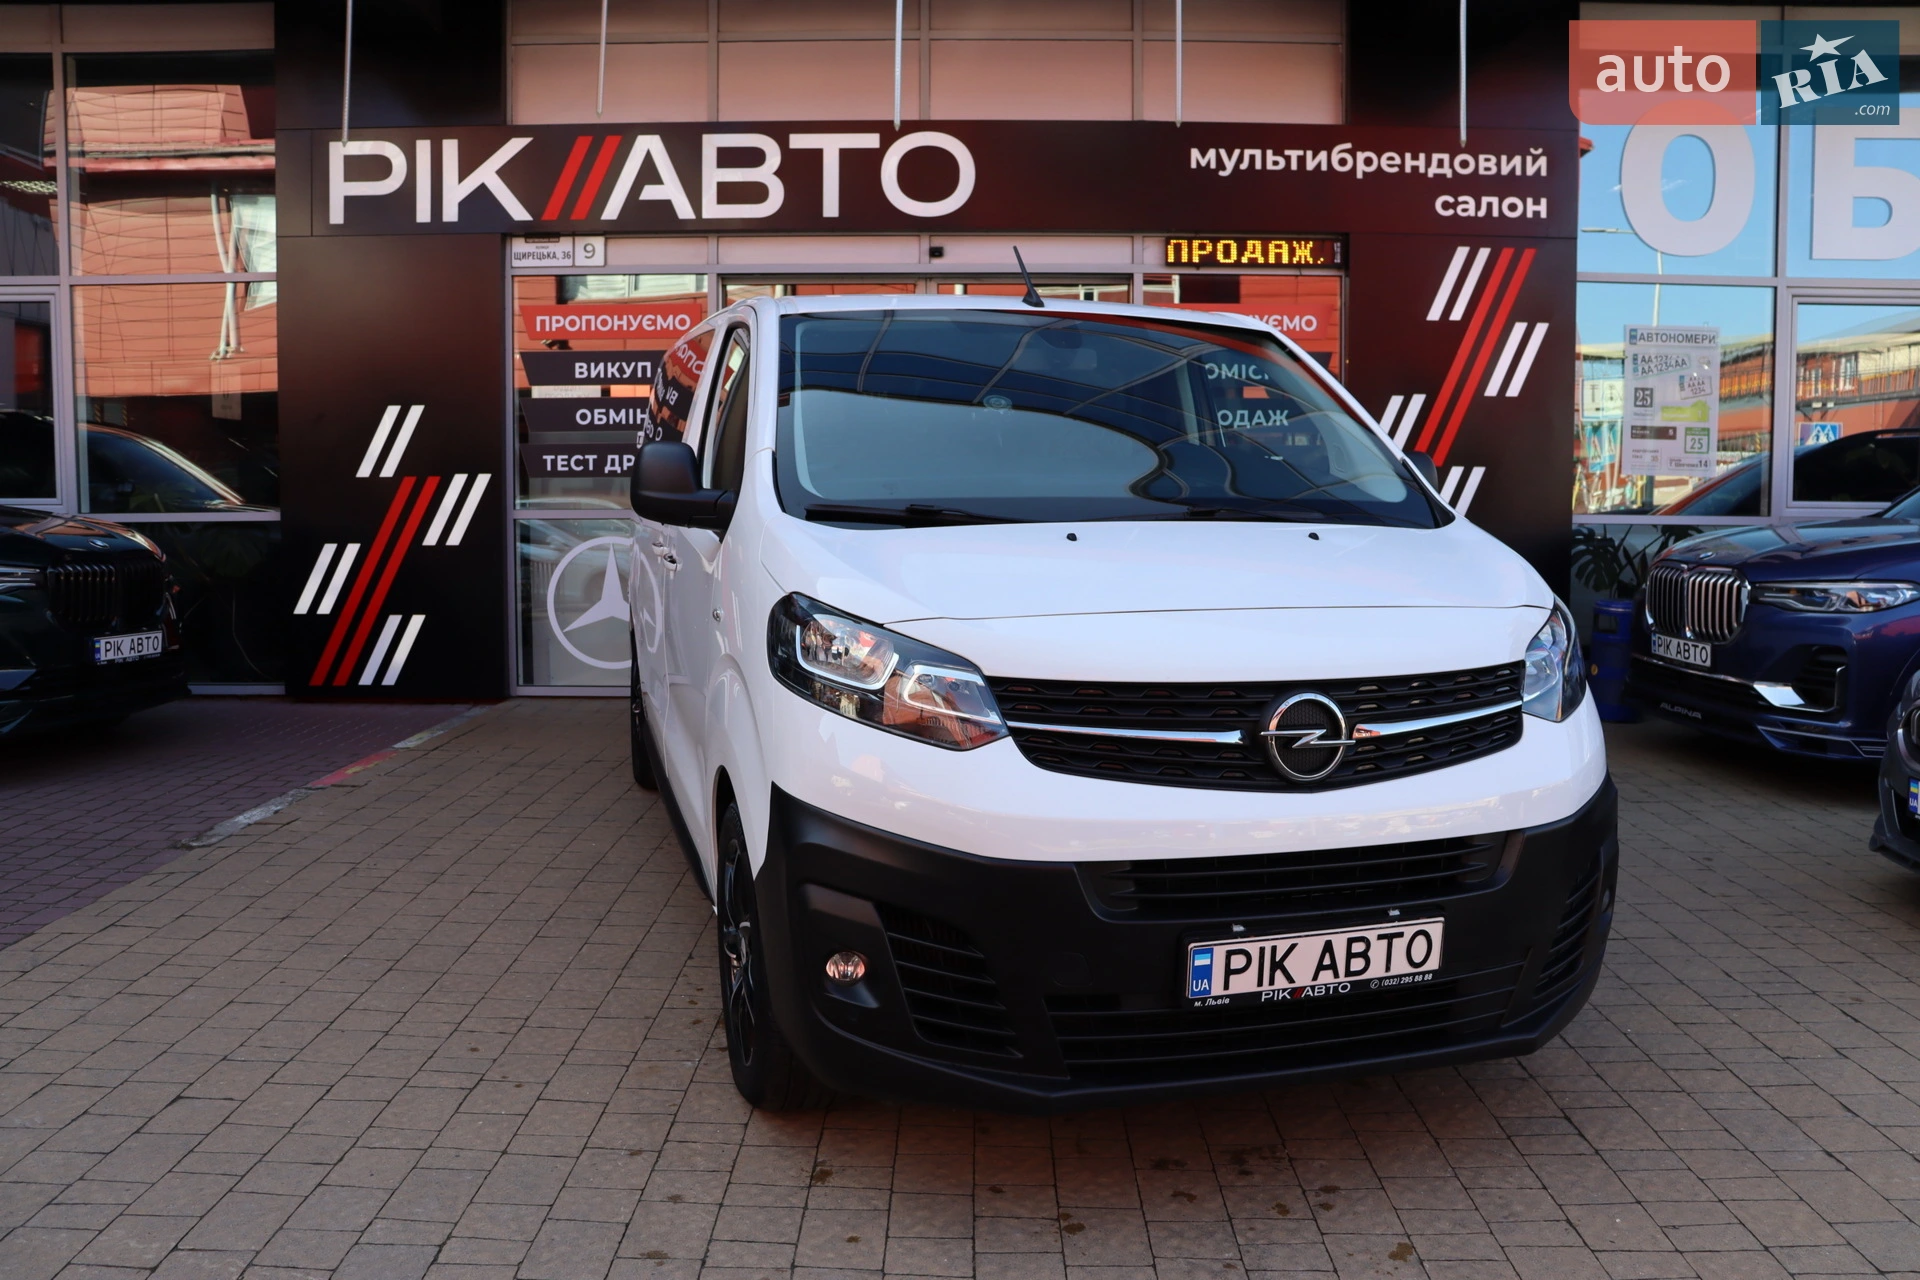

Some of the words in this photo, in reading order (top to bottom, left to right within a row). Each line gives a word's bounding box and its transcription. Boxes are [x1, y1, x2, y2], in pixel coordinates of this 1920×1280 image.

[1189, 142, 1548, 179] мультибрендовий
[1434, 194, 1548, 218] салон
[513, 251, 560, 261] ЩИРЕЦЬКА,
[561, 250, 572, 260] 36
[583, 242, 596, 259] 9
[535, 314, 691, 332] ПРОПОНУЄМО
[1638, 332, 1716, 345] АВТОНОМЕРИ
[574, 361, 652, 379] ВИКУП
[1635, 389, 1651, 406] 25
[575, 408, 649, 426] ОБМІН
[1689, 437, 1704, 450] 25
[543, 455, 598, 472] ТЕСТ
[1698, 459, 1708, 468] 14
[1660, 702, 1702, 719] ALPINA
[1193, 978, 1210, 992] UA
[1381, 977, 1400, 987] (032)
[1400, 976, 1413, 984] 295
[1414, 974, 1424, 982] 88
[1424, 973, 1433, 981] 88
